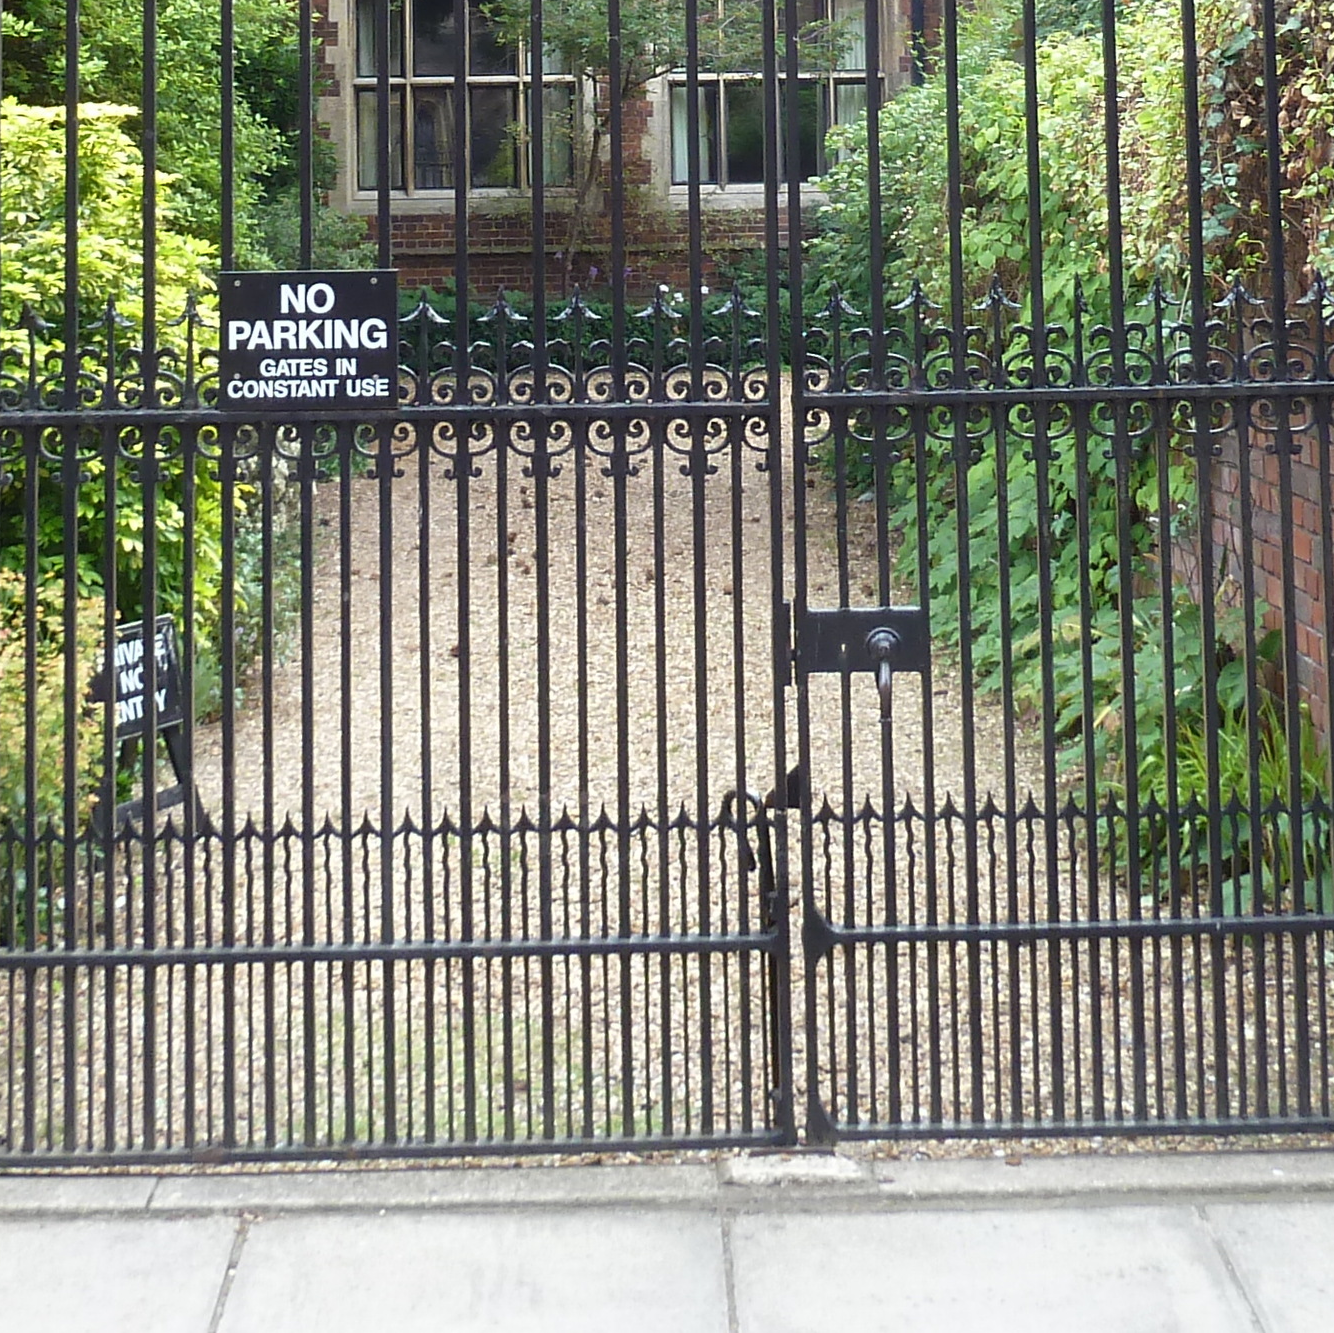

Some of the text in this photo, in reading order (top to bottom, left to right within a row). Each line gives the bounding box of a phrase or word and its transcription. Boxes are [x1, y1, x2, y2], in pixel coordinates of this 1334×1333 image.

[280, 282, 336, 314] NO
[228, 318, 388, 351] PARKING
[259, 358, 357, 377] GATES IN
[227, 378, 390, 399] CONSTANT USE
